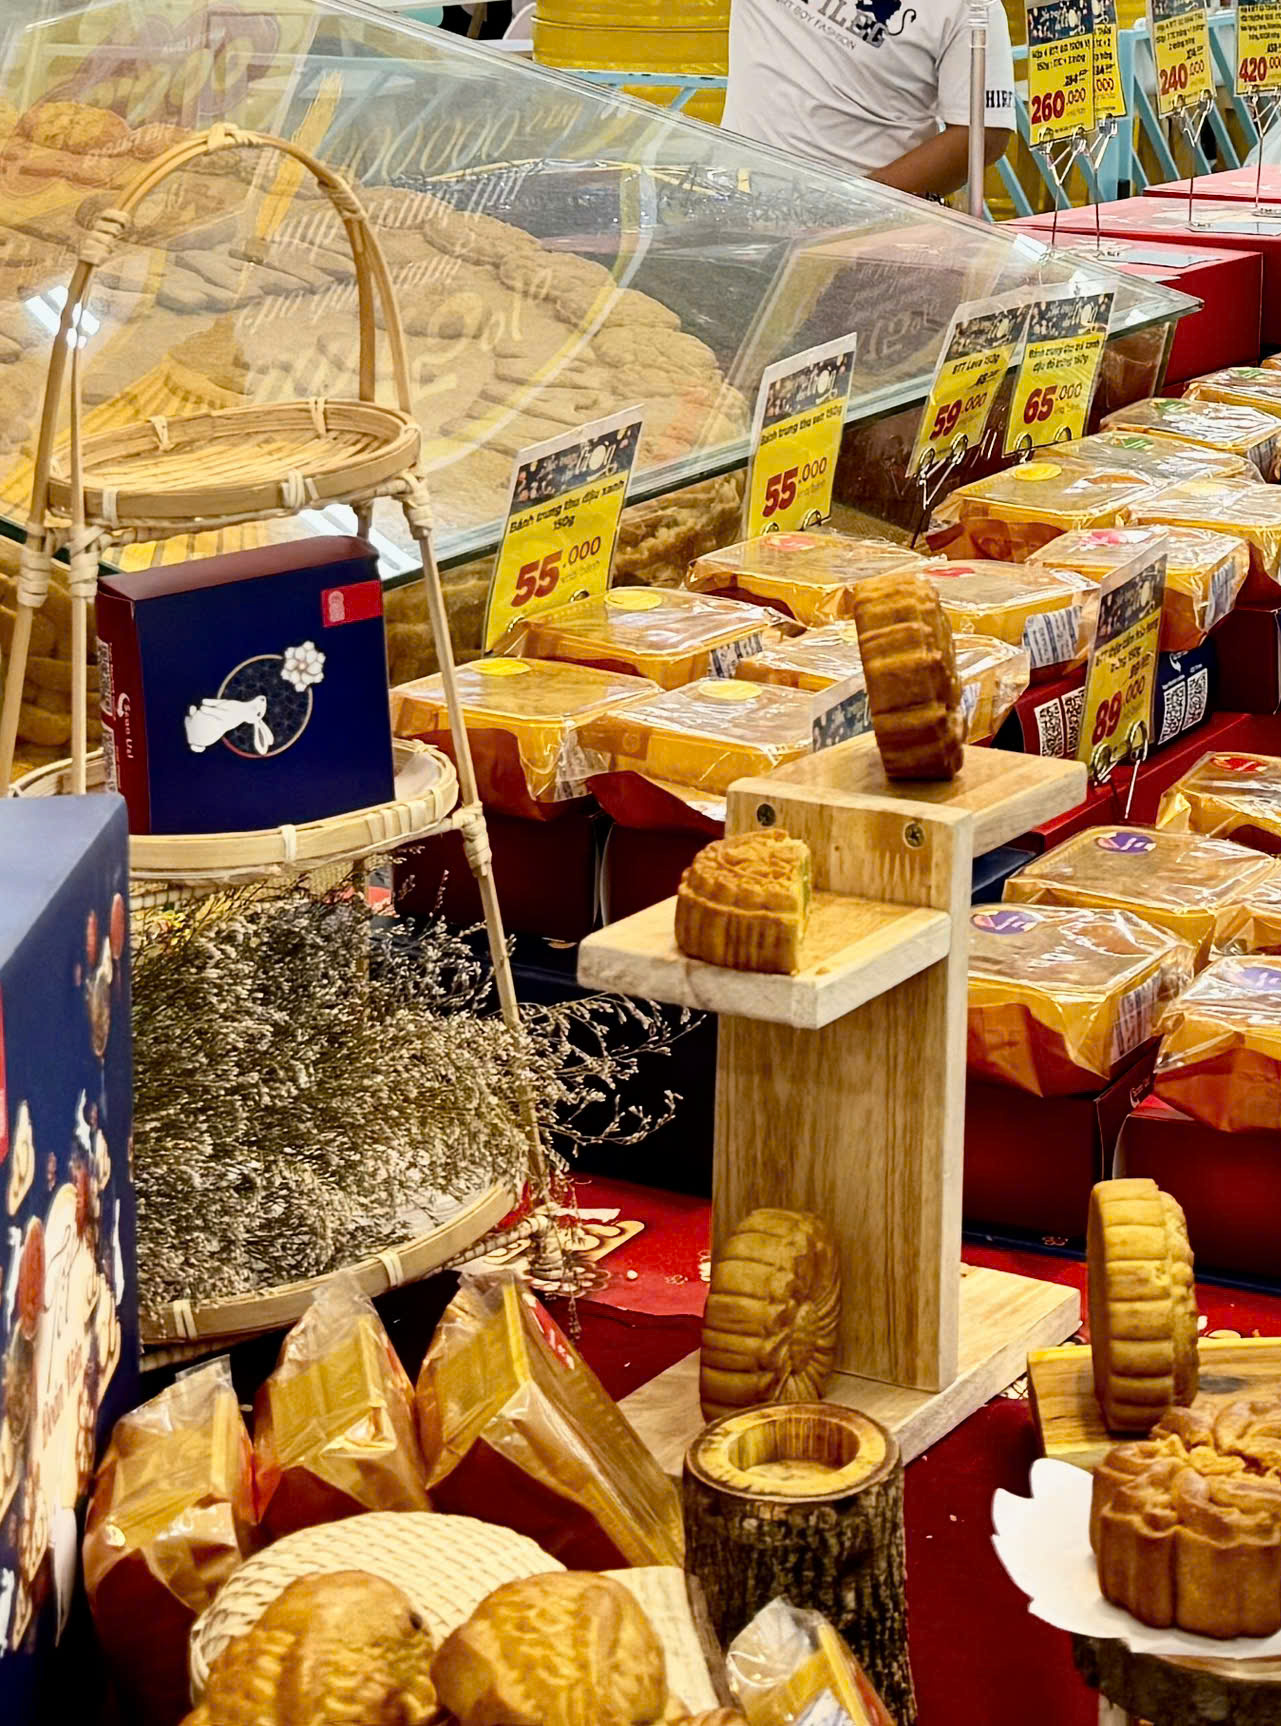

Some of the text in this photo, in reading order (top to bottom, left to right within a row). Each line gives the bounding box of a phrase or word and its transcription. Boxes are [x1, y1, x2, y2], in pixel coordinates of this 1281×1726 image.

[1160, 60, 1205, 95] 240.000
[1031, 87, 1086, 125] 260.000
[929, 392, 987, 440] 59.000
[1024, 383, 1083, 424] 65.000
[762, 457, 827, 518] 55.000
[511, 536, 601, 608] 55.000
[1092, 675, 1145, 746] 89.000
